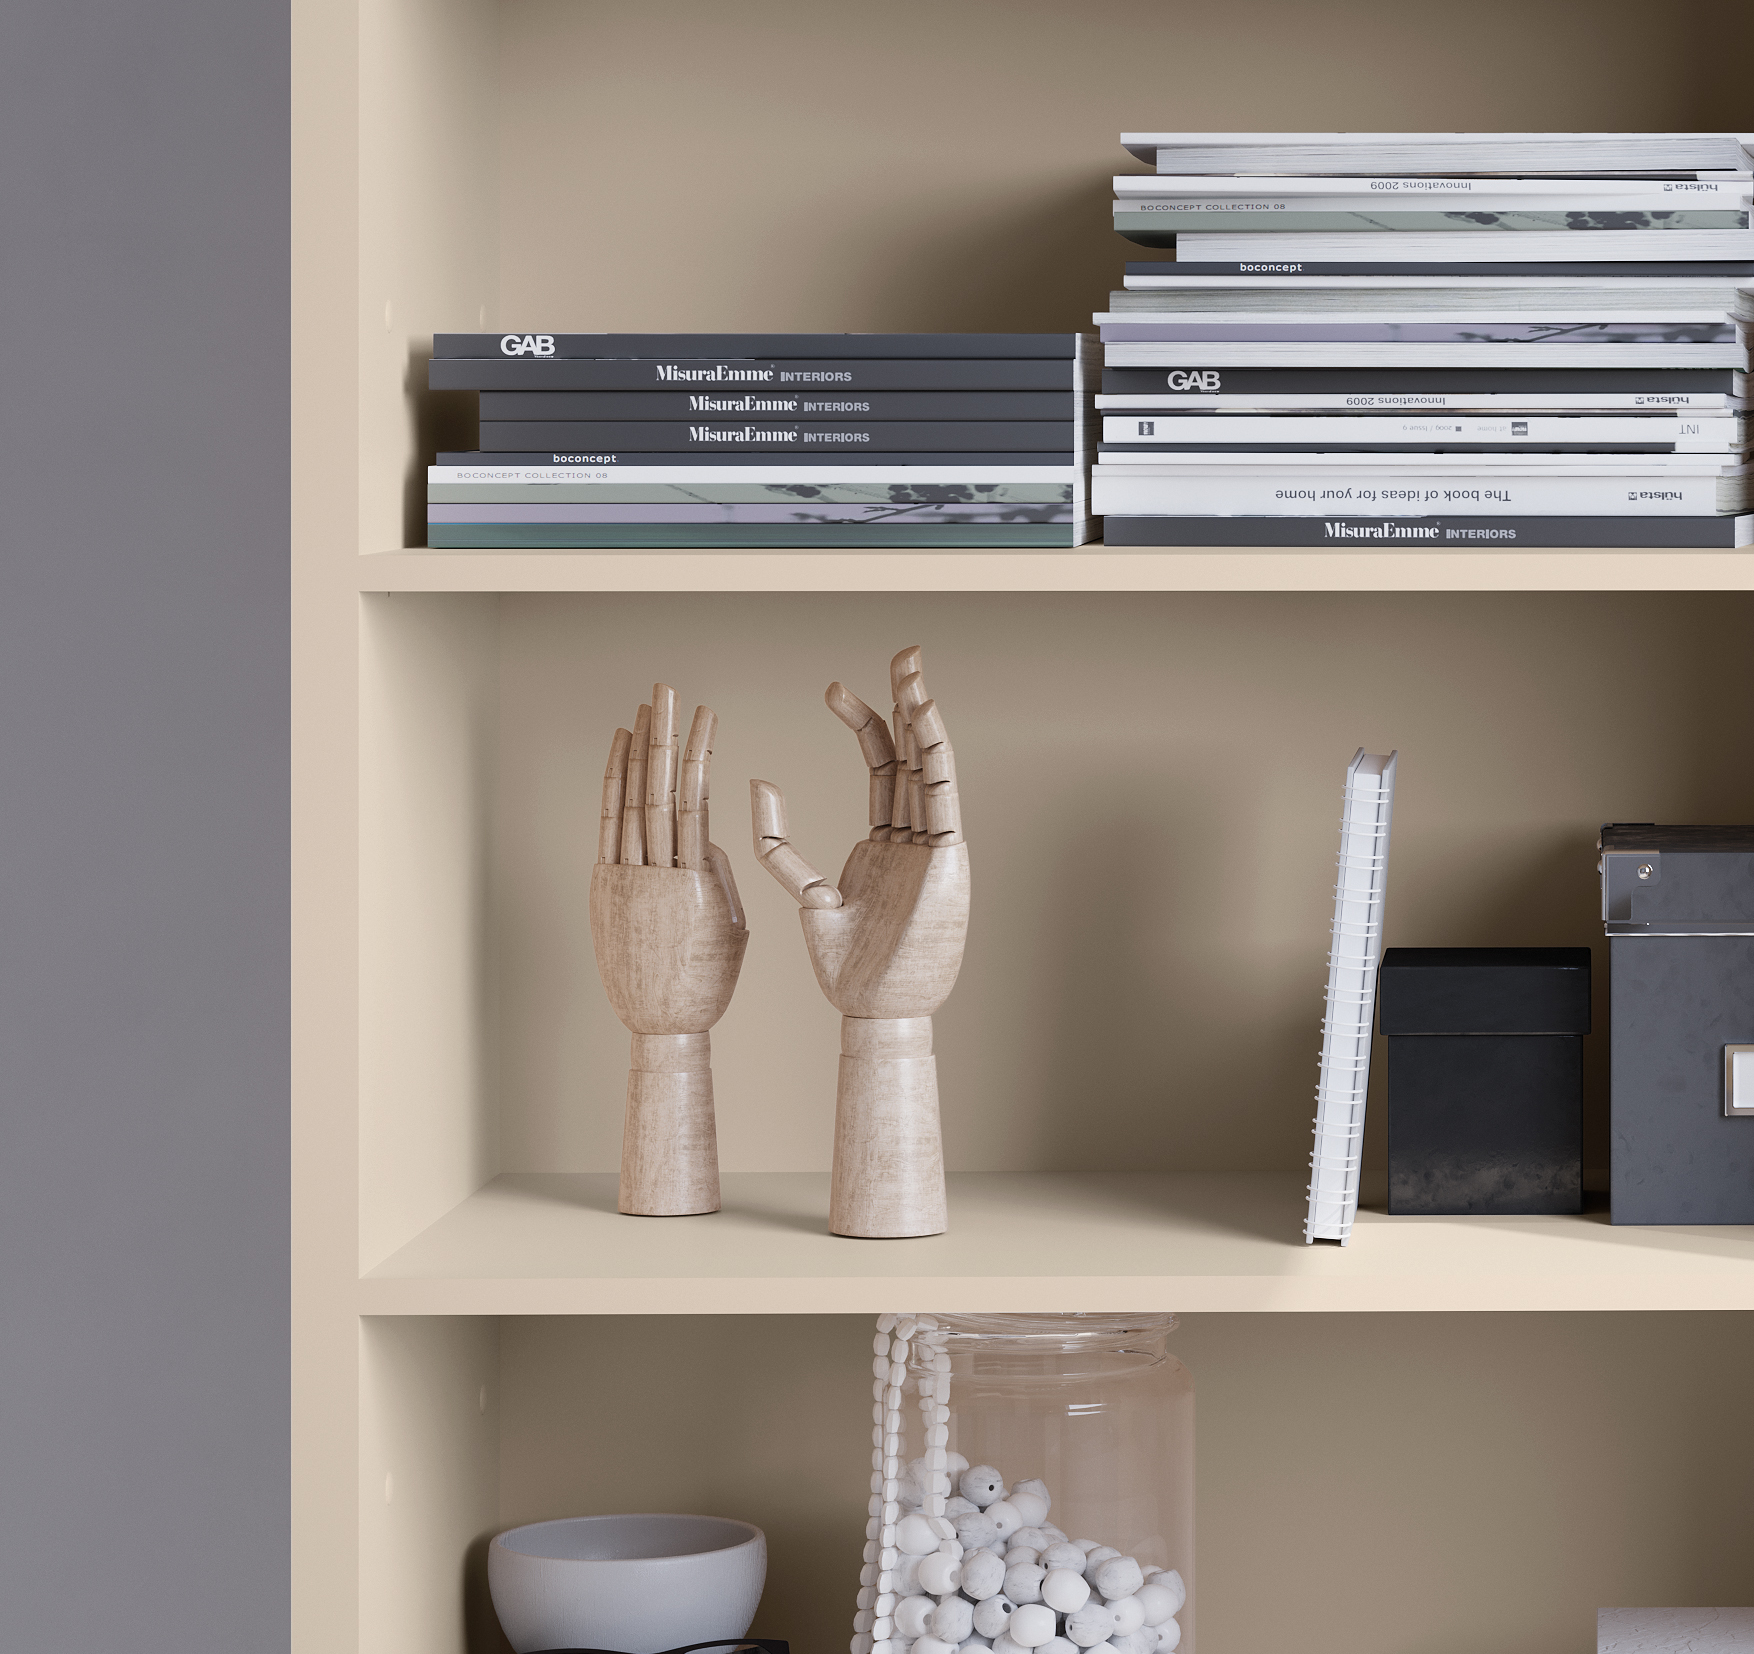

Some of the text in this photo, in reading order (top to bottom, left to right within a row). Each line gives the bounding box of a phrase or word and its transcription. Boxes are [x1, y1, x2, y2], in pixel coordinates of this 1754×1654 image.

[1370, 181, 1472, 191] Innovations 2009
[1675, 183, 1718, 192] hülsta
[1205, 203, 1270, 211] COLLECTION
[500, 334, 556, 356] GAB
[780, 371, 853, 382] INTERIORS
[1167, 370, 1222, 391] GAB
[1346, 397, 1446, 406] Innovations 2009
[1646, 396, 1690, 404] hülsta
[803, 402, 870, 412] INTERIORS
[1678, 424, 1700, 435] INT
[803, 432, 870, 443] INTERIORS
[1275, 488, 1512, 502] The book of ideas for your home
[1639, 491, 1683, 501] hülsta
[1445, 528, 1517, 539] INTERIORS
